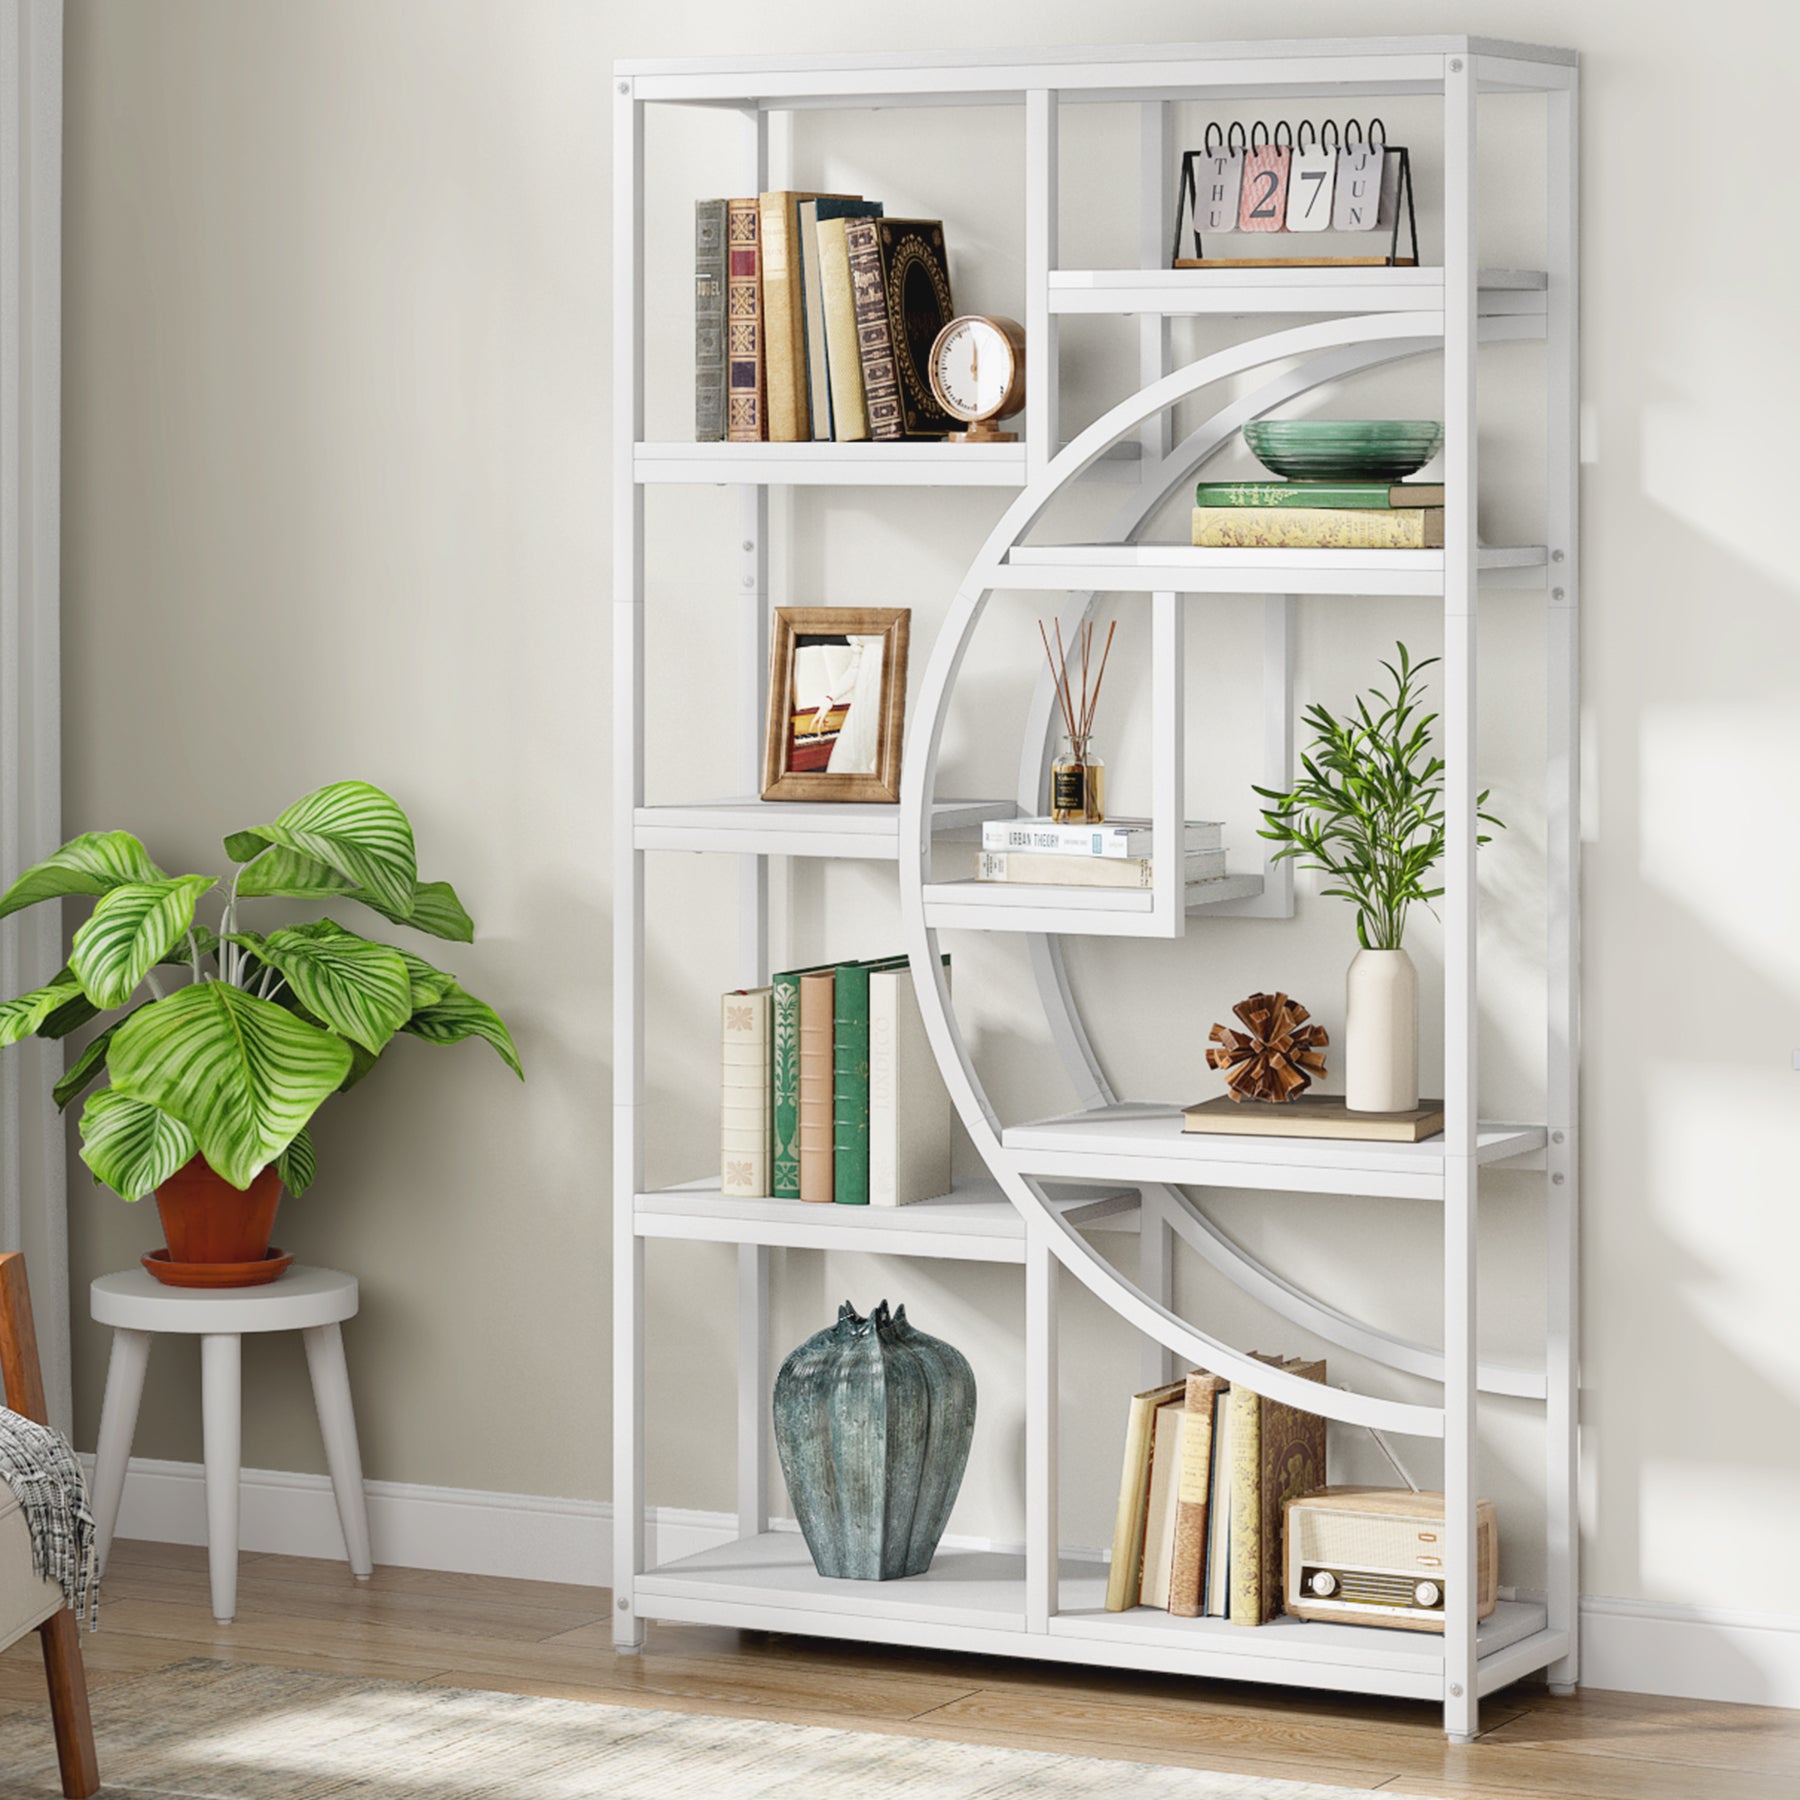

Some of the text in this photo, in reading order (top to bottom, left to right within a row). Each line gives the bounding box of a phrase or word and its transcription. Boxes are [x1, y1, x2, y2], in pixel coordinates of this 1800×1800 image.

[1209, 158, 1228, 227] THU
[1349, 153, 1368, 225] JUN
[1008, 831, 1031, 846] URBAN
[1034, 832, 1060, 848] THEORY
